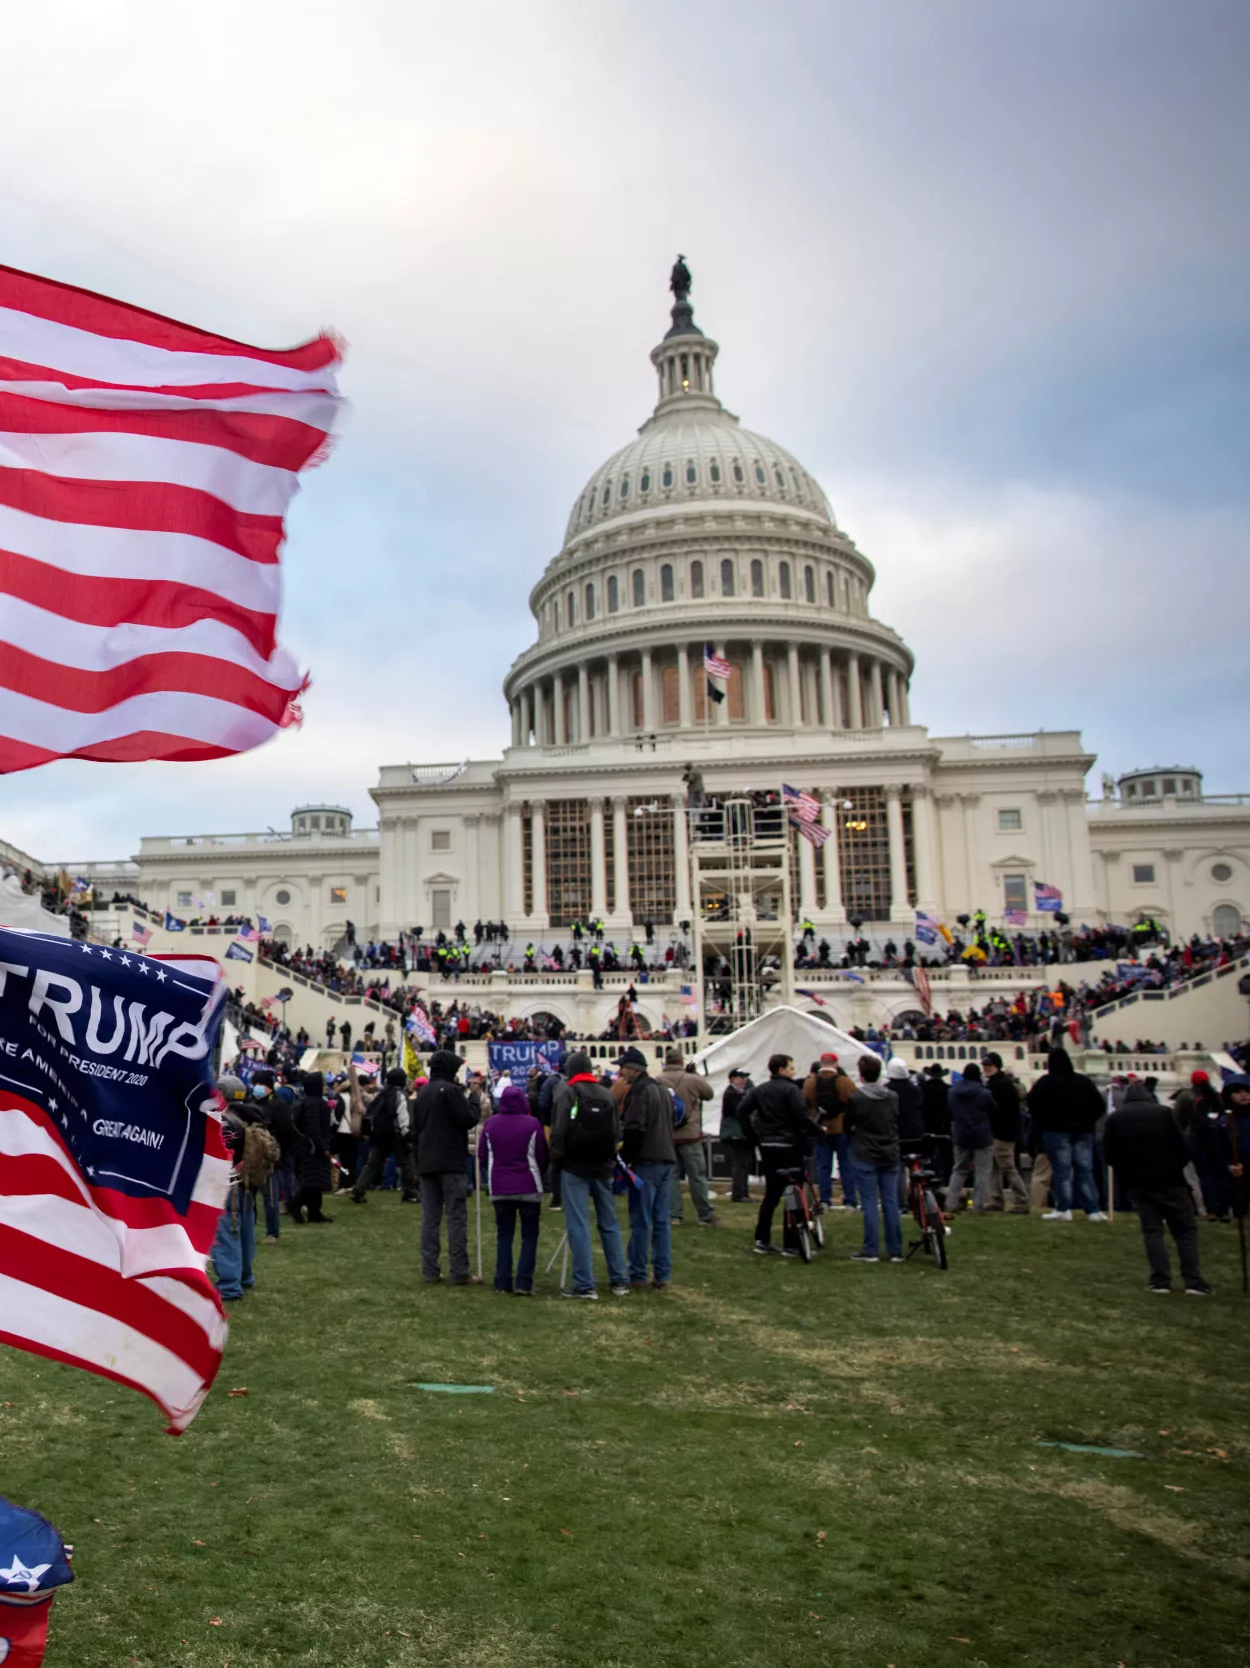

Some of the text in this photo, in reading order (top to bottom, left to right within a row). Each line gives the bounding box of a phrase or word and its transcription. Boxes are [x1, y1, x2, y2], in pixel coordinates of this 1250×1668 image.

[28, 1014, 149, 1087] FOR PRESIDENT 2020
[490, 1040, 559, 1062] TRUMP
[119, 1123, 165, 1150] AGAIN!
